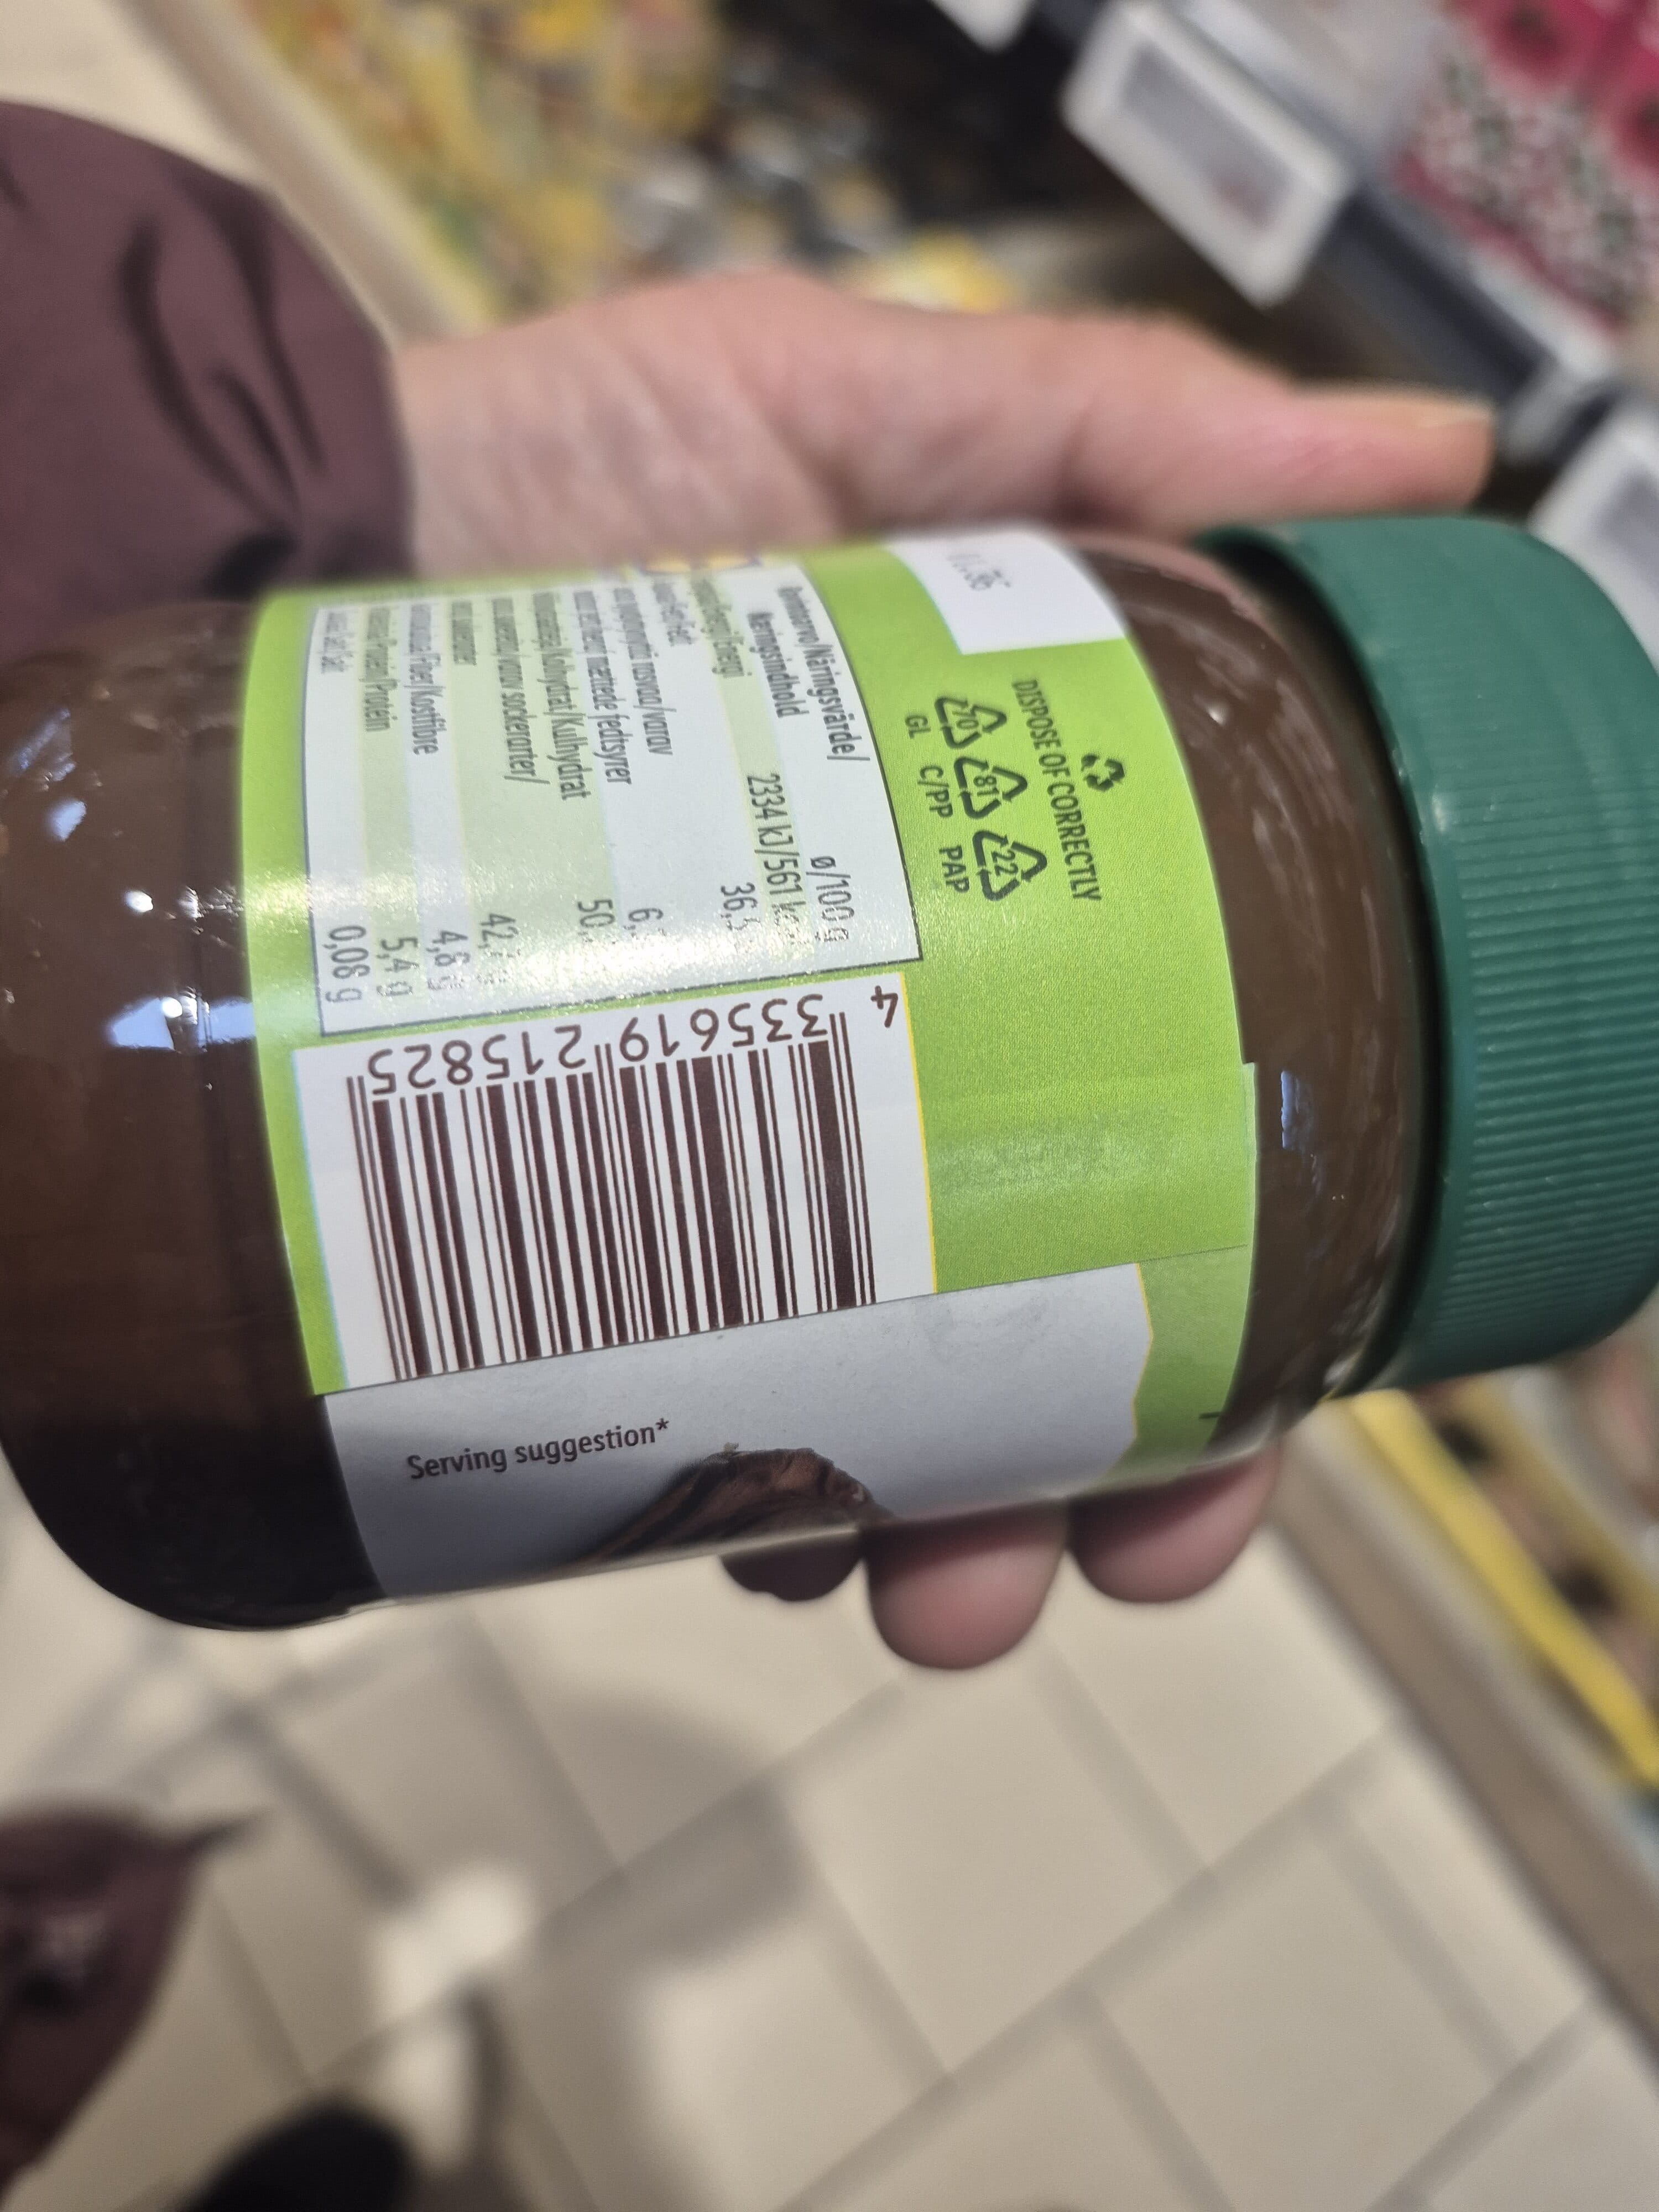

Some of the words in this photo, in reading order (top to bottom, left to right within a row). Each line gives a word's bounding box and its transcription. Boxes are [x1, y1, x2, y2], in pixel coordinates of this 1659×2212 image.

[501, 692, 550, 784] sockerarter/
[905, 714, 931, 739] GL
[1011, 679, 1061, 750] DISPOSE
[588, 713, 633, 785] fedtsyrer
[1038, 753, 1070, 778] OF
[747, 773, 788, 821] 2334
[917, 765, 953, 818] C/PP
[973, 774, 1000, 797] 81
[754, 824, 801, 896] kJ/561
[990, 849, 1019, 877] 22
[1047, 782, 1102, 901] CORRECTLY
[939, 845, 970, 893] PAP
[323, 925, 371, 979] 0,08
[377, 937, 419, 973] 5,4
[426, 930, 470, 967] 4,8
[325, 988, 362, 1002] g
[376, 981, 413, 996] g
[870, 985, 899, 1028] 4
[619, 993, 828, 1062] 335619
[368, 1024, 587, 1095] 215825
[407, 1447, 508, 1479] Serving
